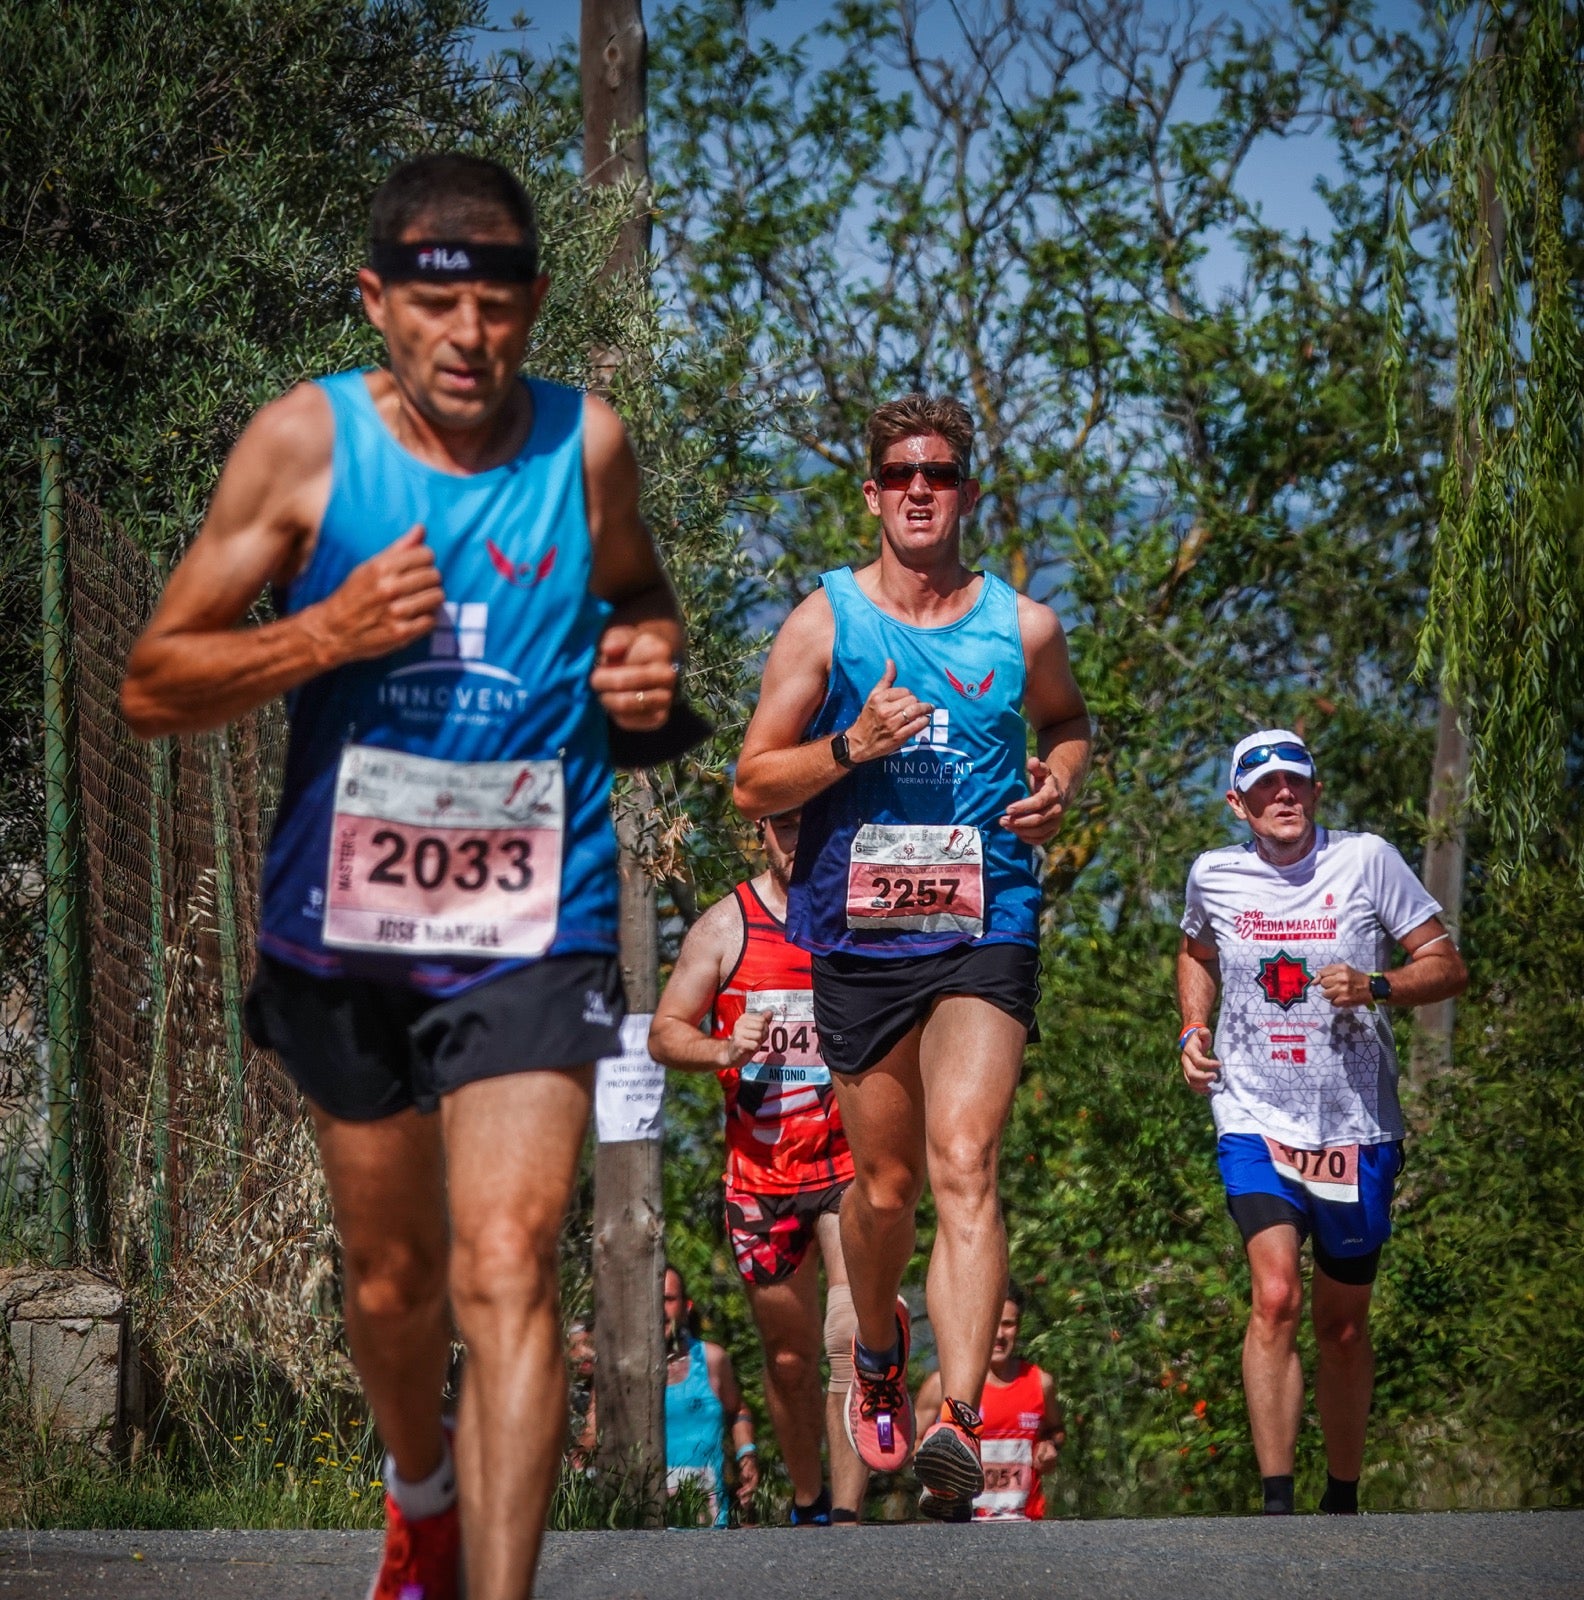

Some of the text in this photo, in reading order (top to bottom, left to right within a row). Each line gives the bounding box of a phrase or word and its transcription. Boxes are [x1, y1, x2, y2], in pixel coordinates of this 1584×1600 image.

[418, 247, 470, 270] FILA
[378, 684, 528, 711] INNOVENT
[883, 760, 975, 775] INNOVENT
[368, 830, 534, 893] 2033
[871, 877, 961, 909] 2257
[1252, 919, 1284, 932] MEDIA
[1286, 915, 1337, 932] MARATÓN
[769, 1068, 806, 1082] ANTONIO
[1279, 1144, 1346, 1179] 070
[985, 1467, 1023, 1490] 051
